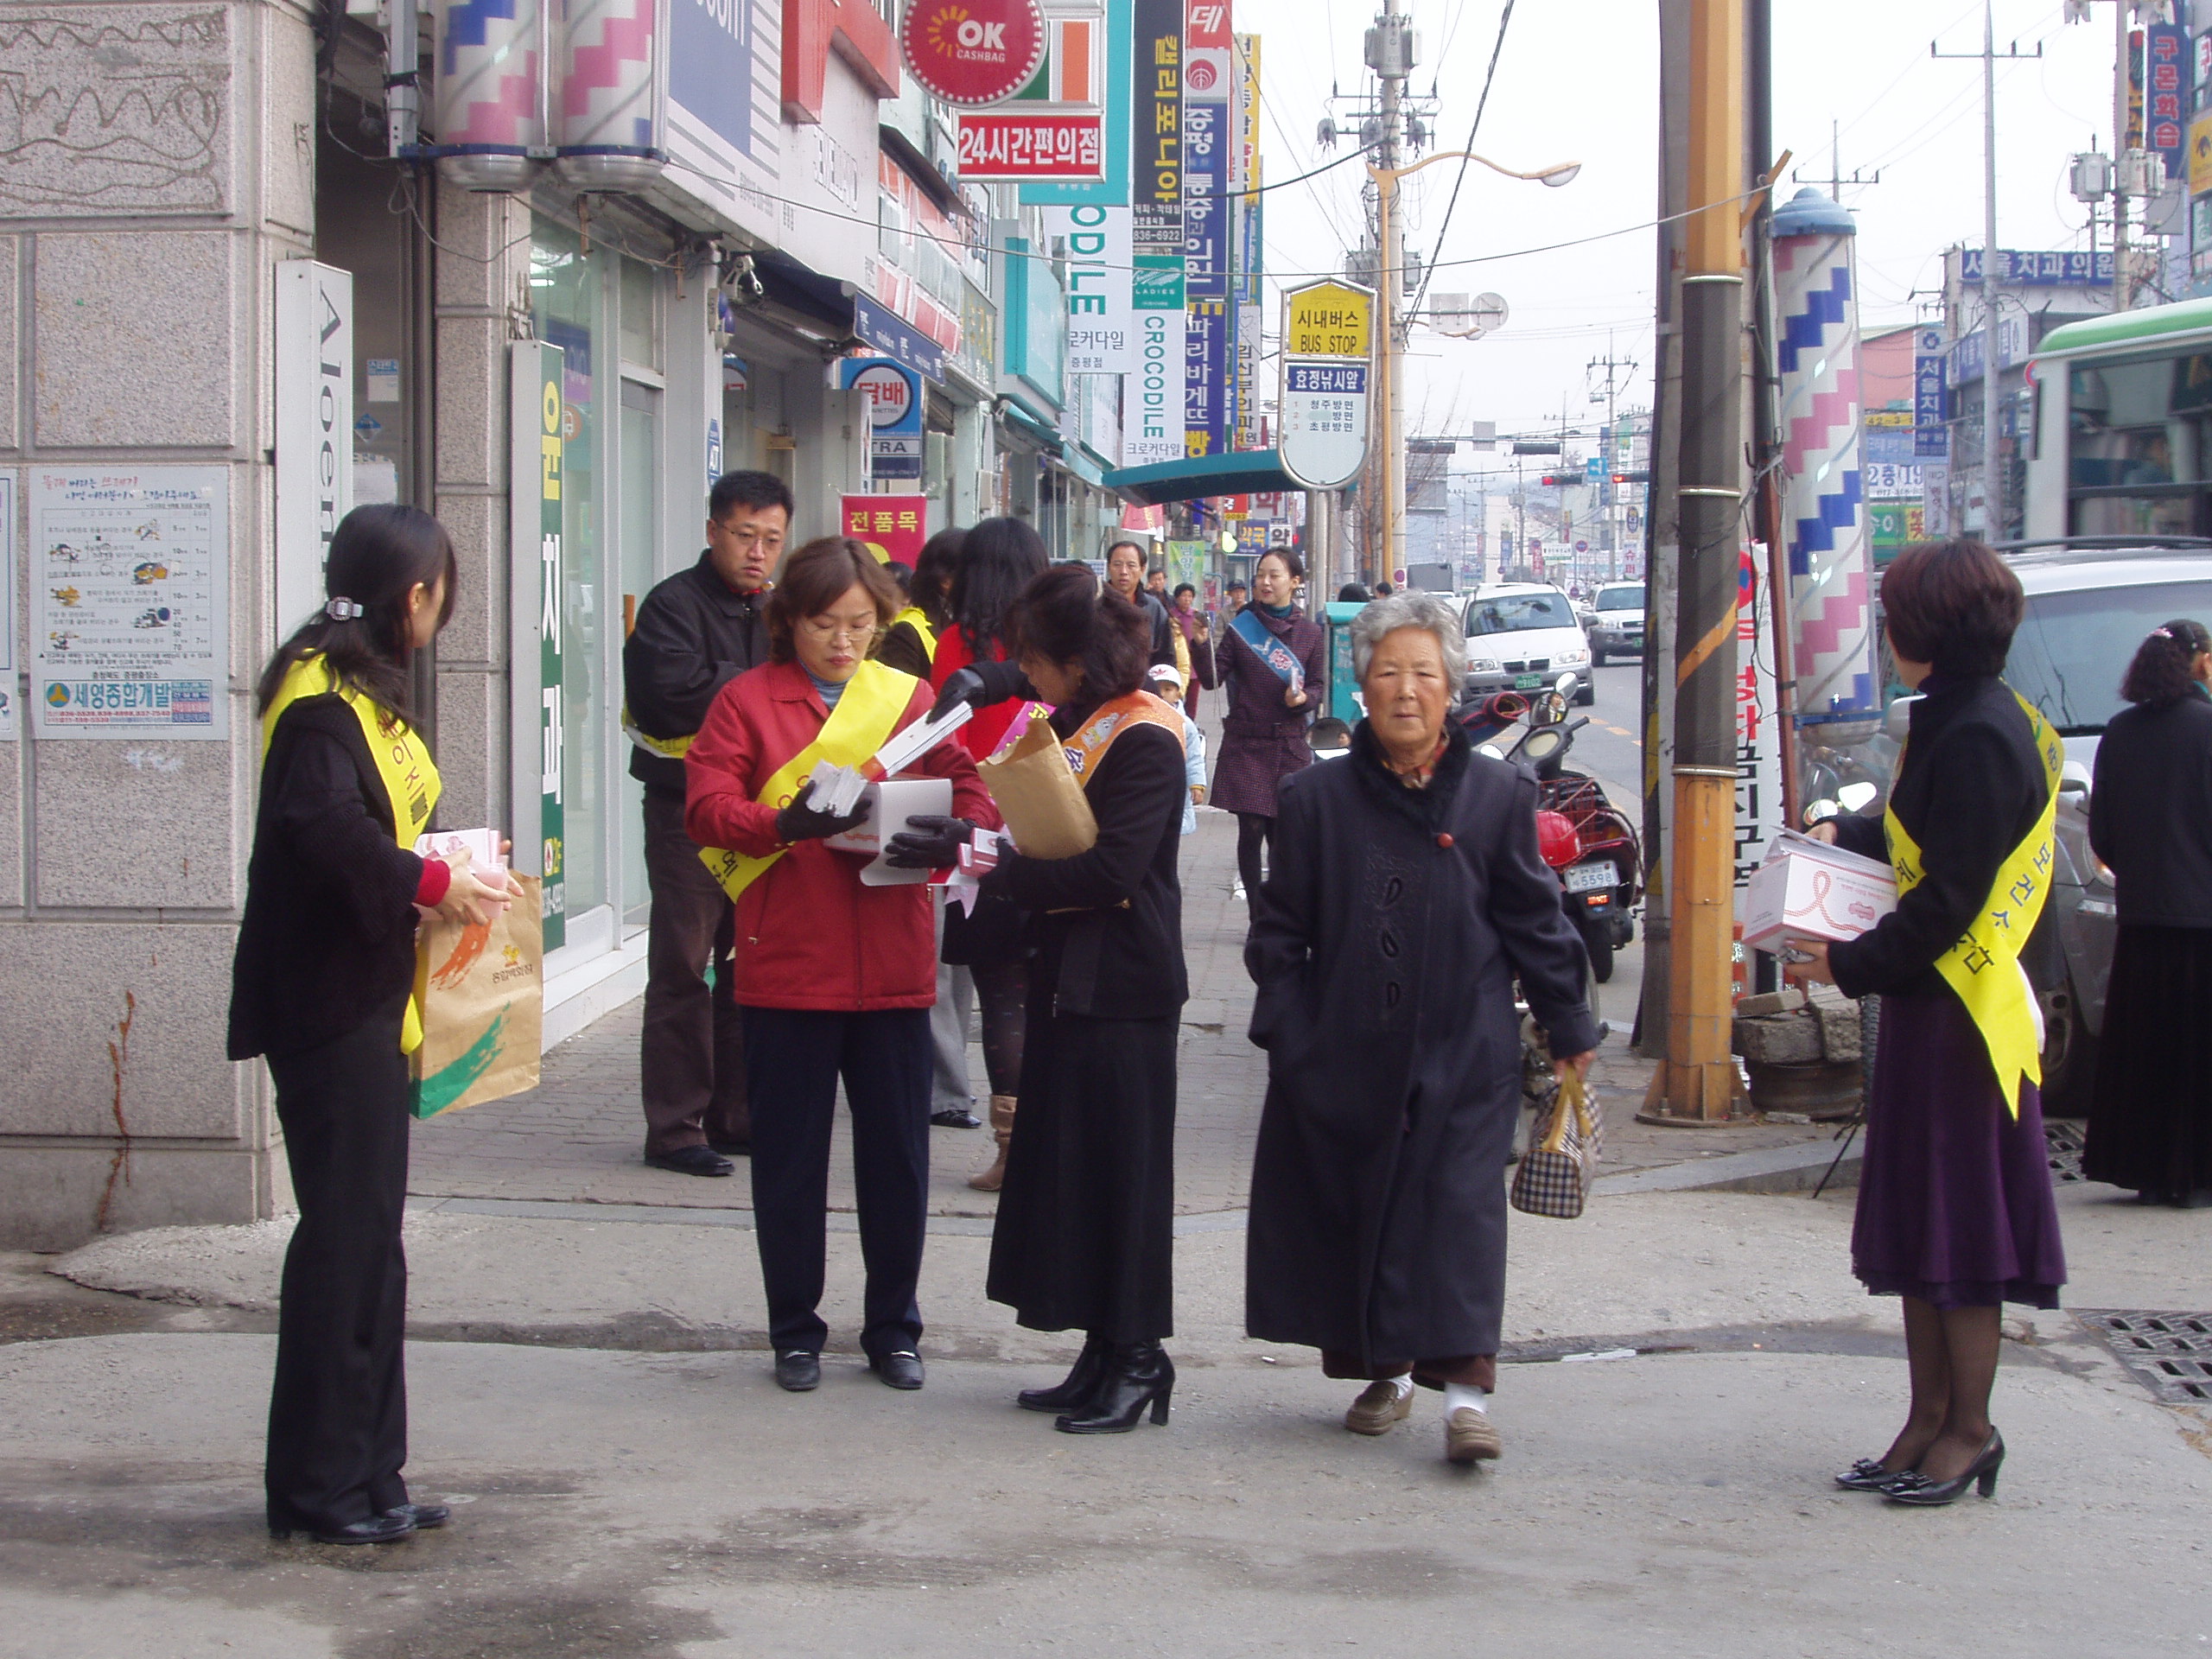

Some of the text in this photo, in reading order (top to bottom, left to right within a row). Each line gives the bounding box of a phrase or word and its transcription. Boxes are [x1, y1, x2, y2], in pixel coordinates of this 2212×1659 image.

[957, 20, 1006, 50] OK
[957, 49, 1006, 62] CASHBAG
[1154, 35, 1179, 202] 캘리포니아
[959, 128, 1099, 164] 24시간편의점
[1134, 230, 1179, 240] 836-6922
[1298, 310, 1359, 328] 시내버스
[1300, 334, 1357, 353] BUS STOP
[1144, 316, 1165, 438] CROCODILE
[1185, 318, 1211, 425] 파리바게뜨
[858, 382, 905, 405] 담배
[1127, 442, 1180, 456] 크로커다일
[850, 512, 918, 533] 전품목
[541, 381, 563, 805] 윤치과
[74, 683, 171, 709] 세영종합개발
